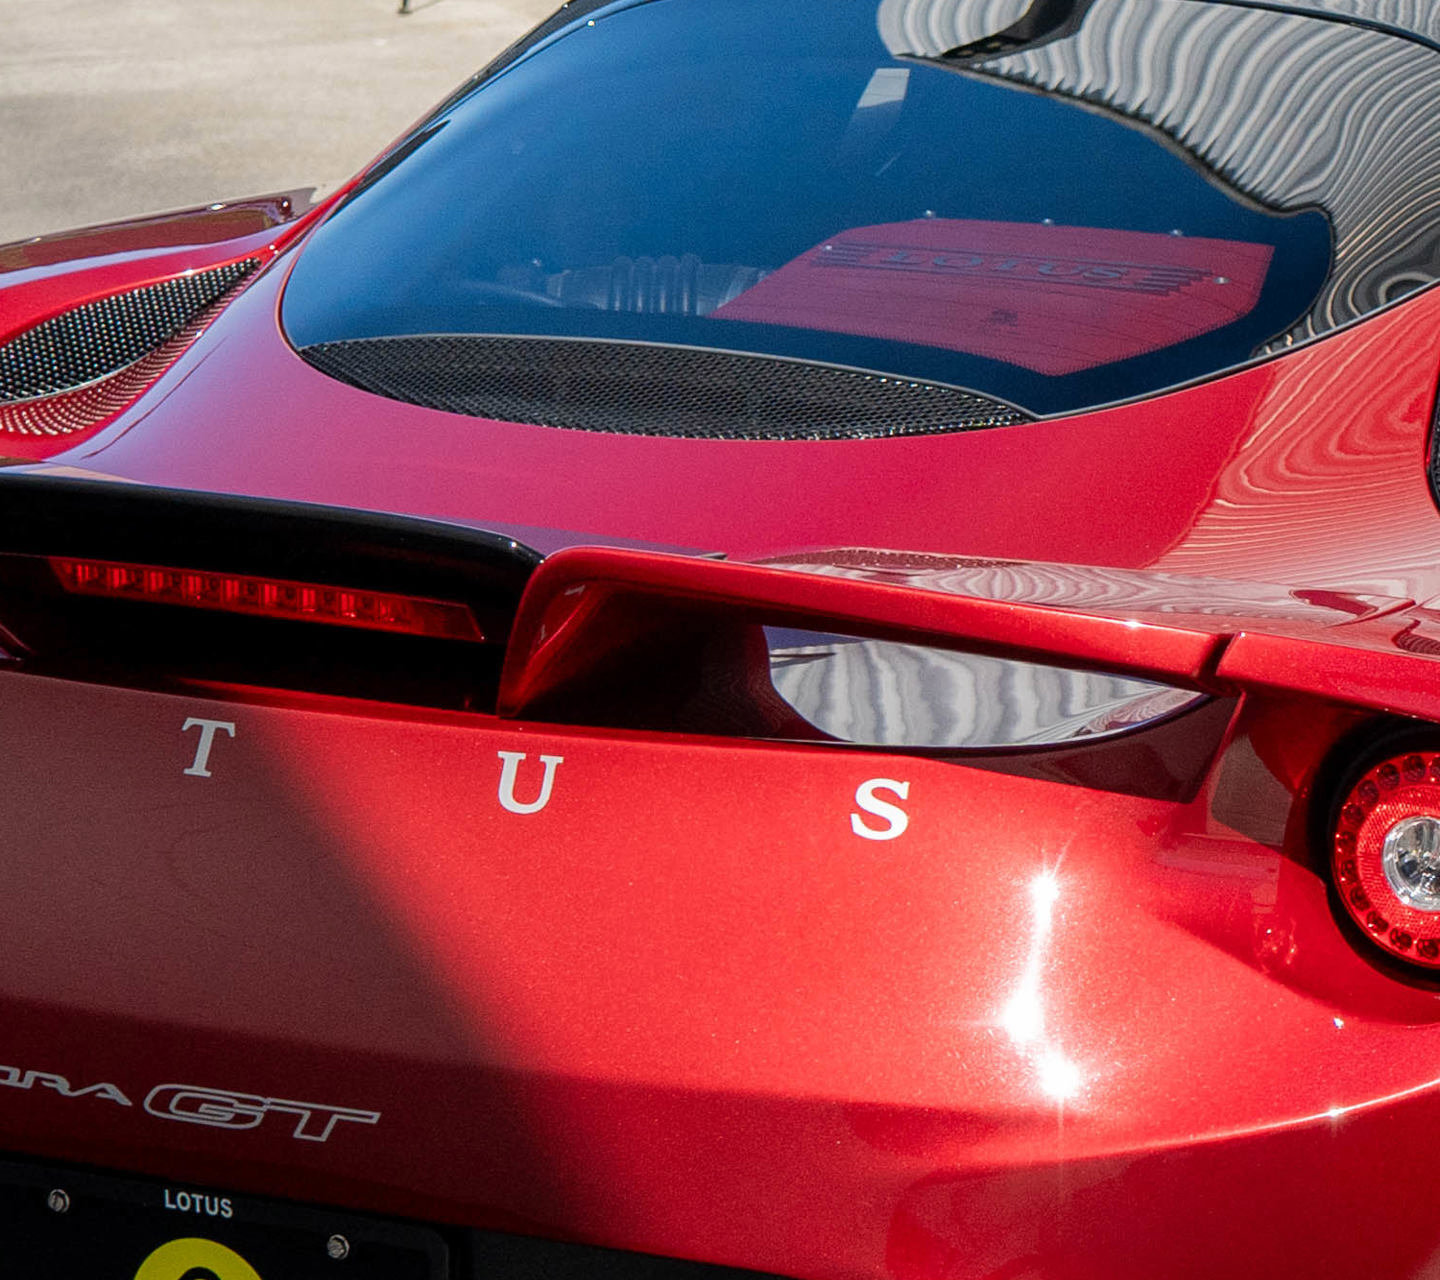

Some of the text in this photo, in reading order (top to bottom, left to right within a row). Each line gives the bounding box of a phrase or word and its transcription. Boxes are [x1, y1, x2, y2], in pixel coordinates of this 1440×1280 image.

[879, 249, 1131, 281] LOTUS
[143, 1084, 382, 1142] GT
[163, 1188, 234, 1218] LOTUS
